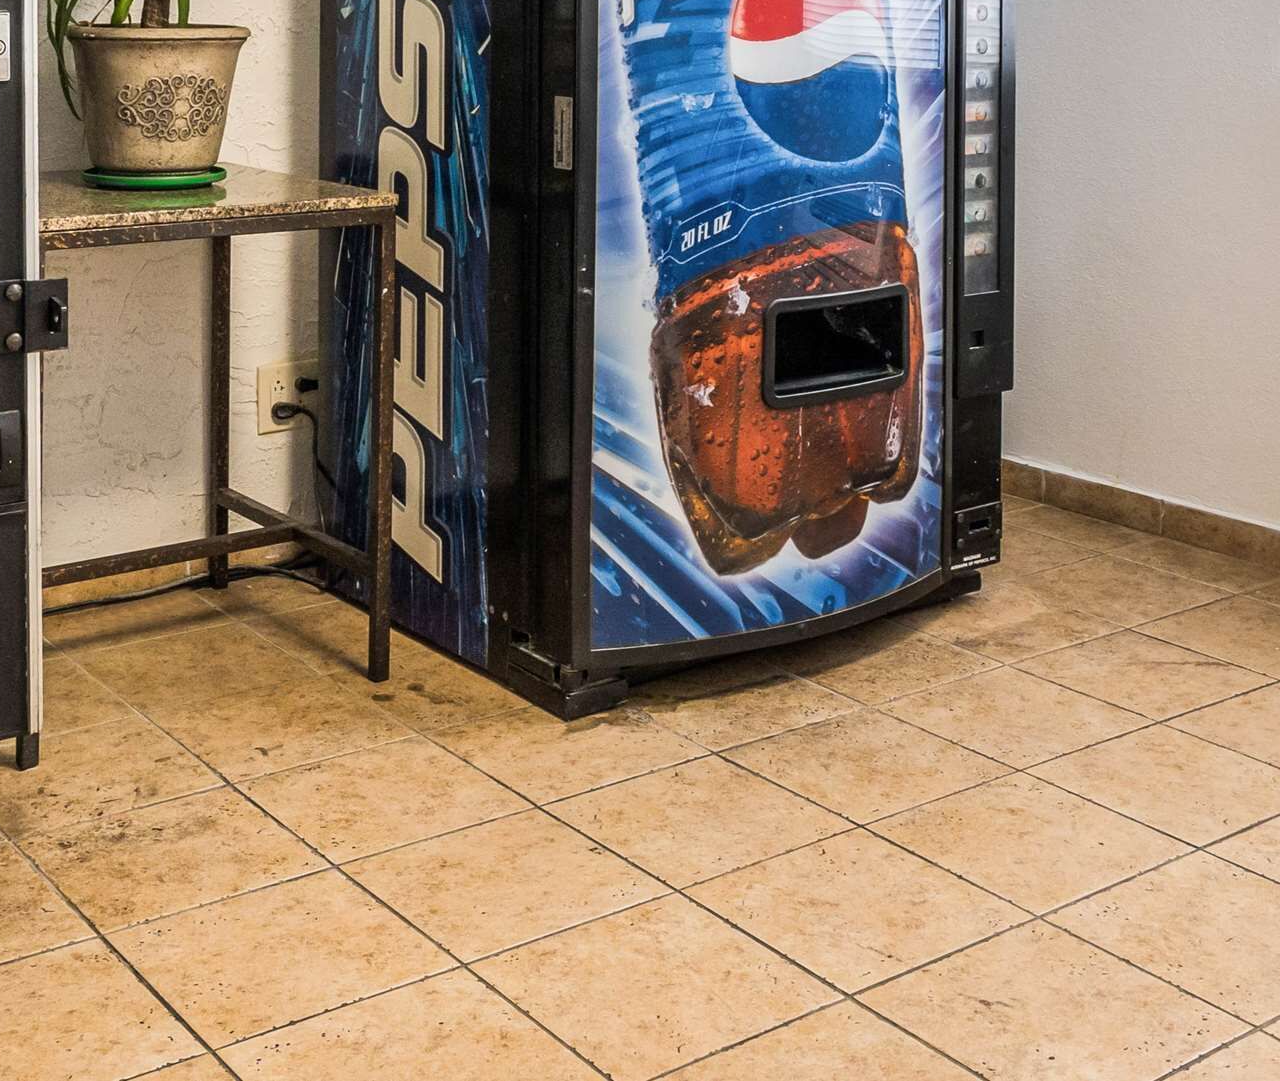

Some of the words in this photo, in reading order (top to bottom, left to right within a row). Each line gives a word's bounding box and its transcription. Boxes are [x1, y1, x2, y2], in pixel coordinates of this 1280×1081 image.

[681, 228, 695, 252] 20
[697, 221, 711, 242] FL
[713, 210, 733, 235] OZ
